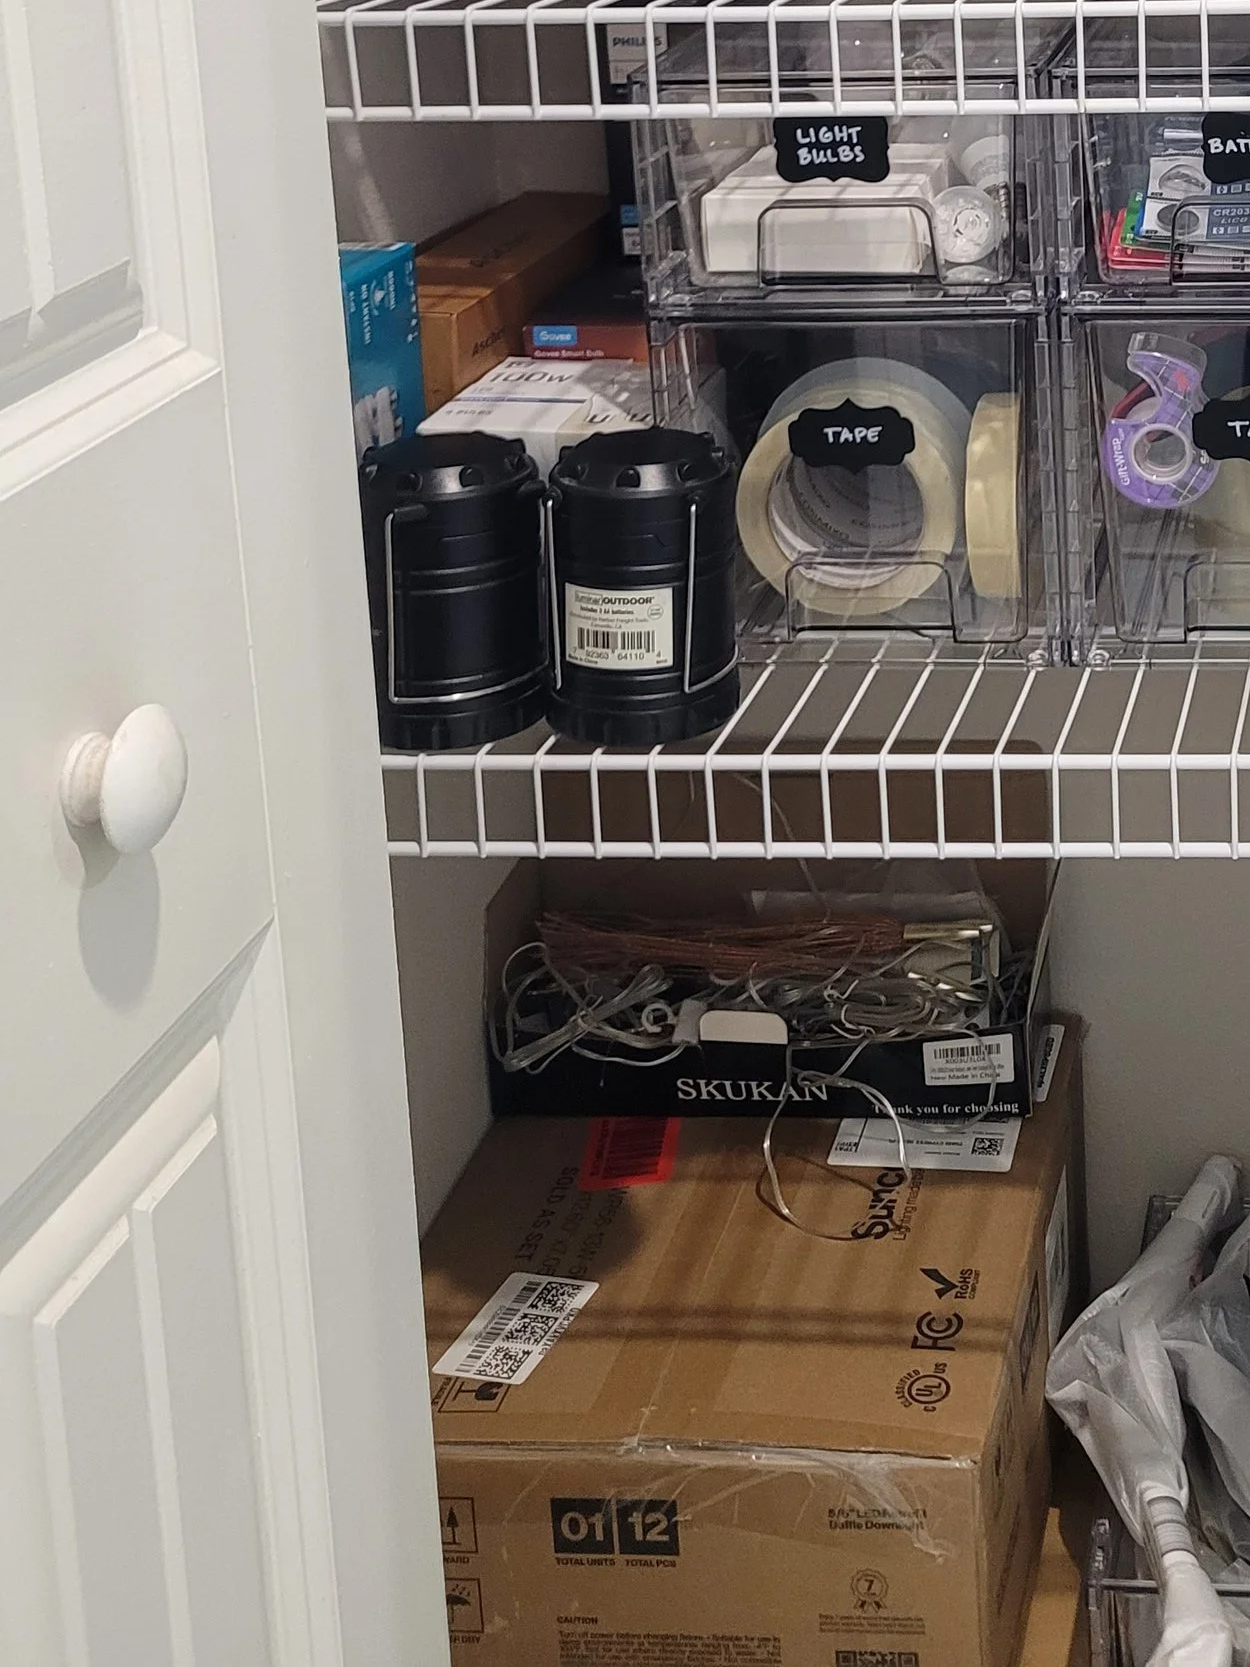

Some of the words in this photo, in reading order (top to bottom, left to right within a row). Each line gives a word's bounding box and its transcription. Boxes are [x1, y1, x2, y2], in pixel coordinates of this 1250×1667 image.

[796, 124, 862, 144] LIGHT
[797, 144, 866, 166] BULBS
[540, 331, 572, 342] Govee
[822, 425, 884, 444] TAPE
[602, 596, 653, 605] OUTDOOR
[617, 652, 645, 661] 64110
[948, 1073, 969, 1081] Made
[675, 1077, 830, 1103] SKUKAN
[917, 1105, 939, 1118] you
[942, 1103, 961, 1114] for
[954, 1268, 973, 1300] RoHS
[933, 1361, 948, 1374] US
[895, 1368, 921, 1409] CLASSIFIED
[915, 1382, 942, 1397] UL
[923, 1405, 937, 1413] C
[560, 1512, 605, 1542] 01
[627, 1511, 670, 1542] 12
[555, 1556, 588, 1566] TOTAL
[588, 1558, 616, 1567] UNITS
[625, 1558, 655, 1567] TOTAL
[864, 1578, 875, 1592] 7
[557, 1616, 599, 1625] CAUTION
